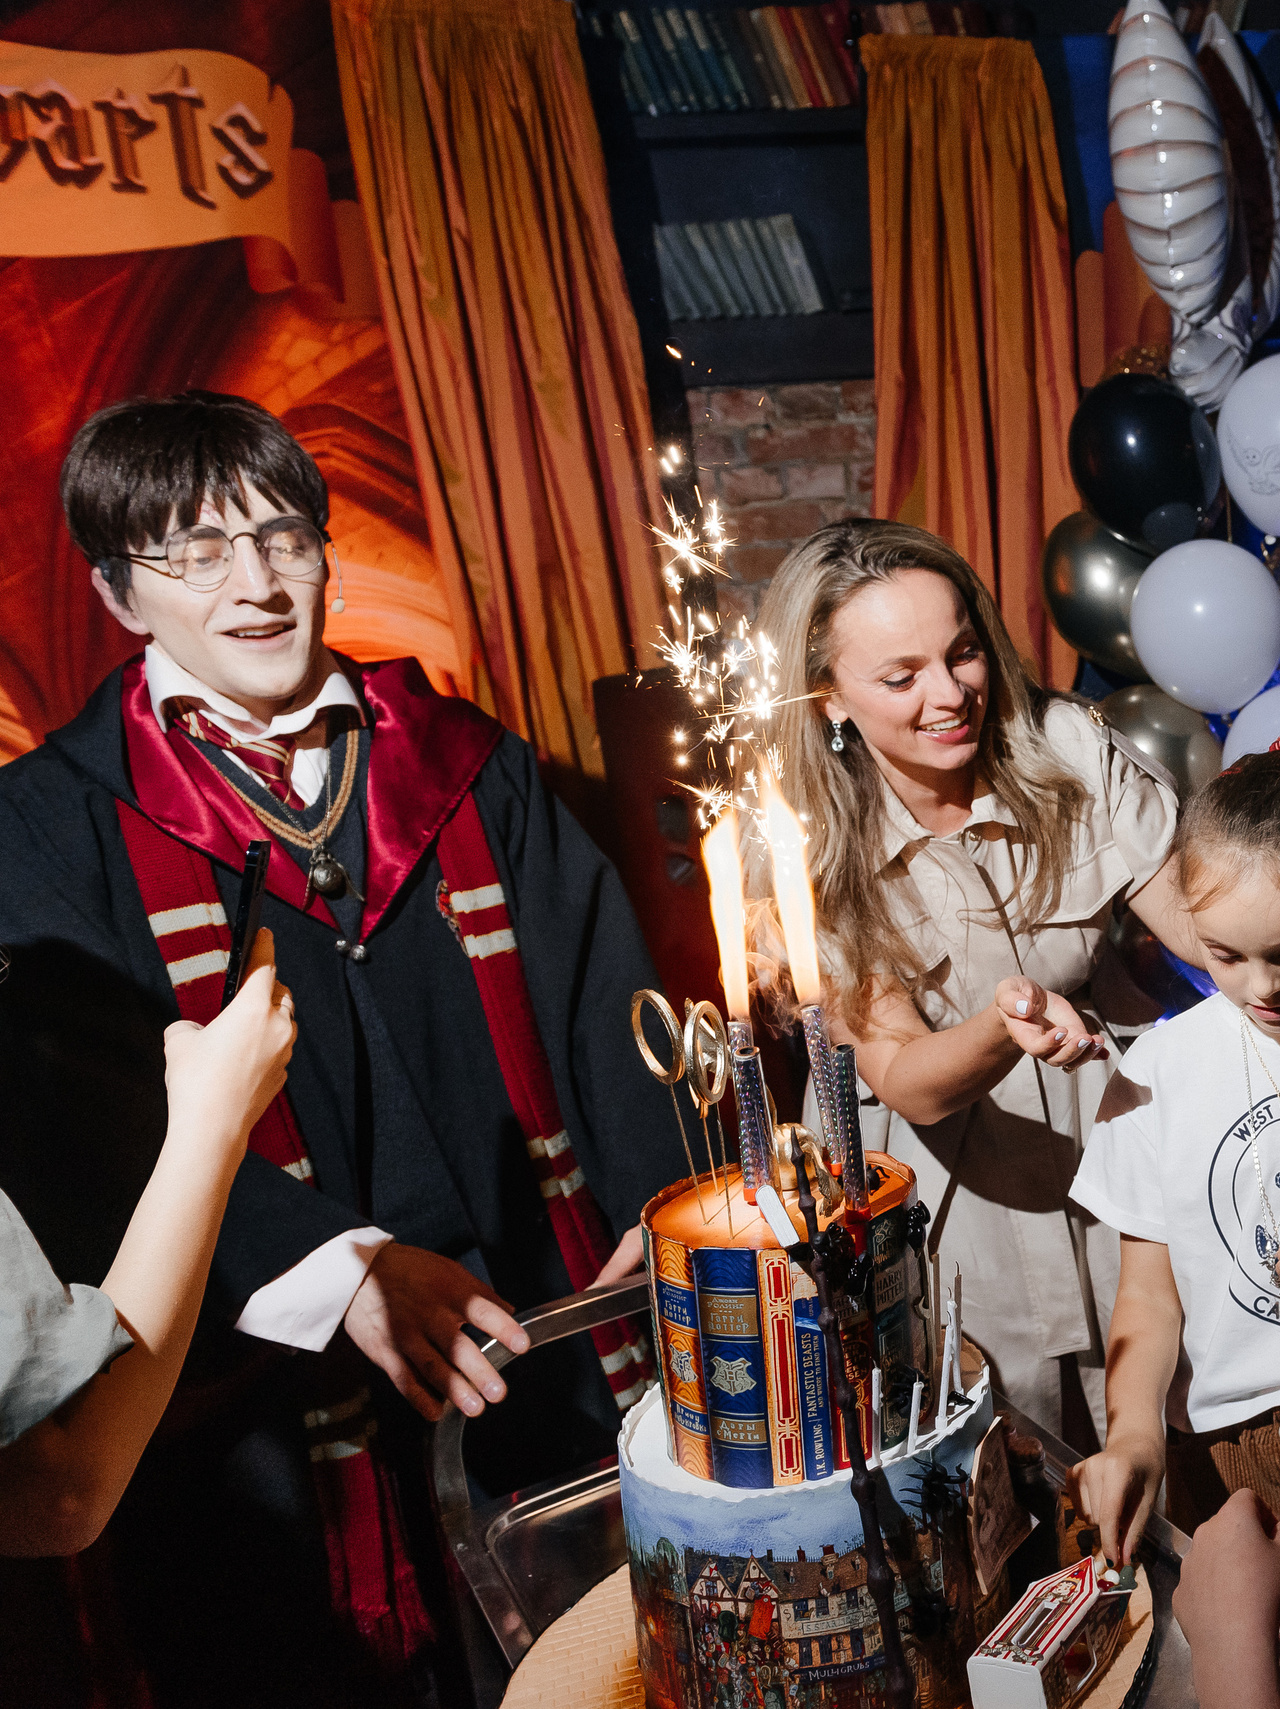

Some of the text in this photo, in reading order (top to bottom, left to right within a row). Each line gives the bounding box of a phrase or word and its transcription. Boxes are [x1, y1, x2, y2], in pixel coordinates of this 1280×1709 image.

[1233, 1104, 1273, 1143] WEST
[801, 1332, 814, 1368] BEASTS
[803, 1369, 818, 1418] FANTASTIC
[813, 1424, 825, 1460] ROWLING
